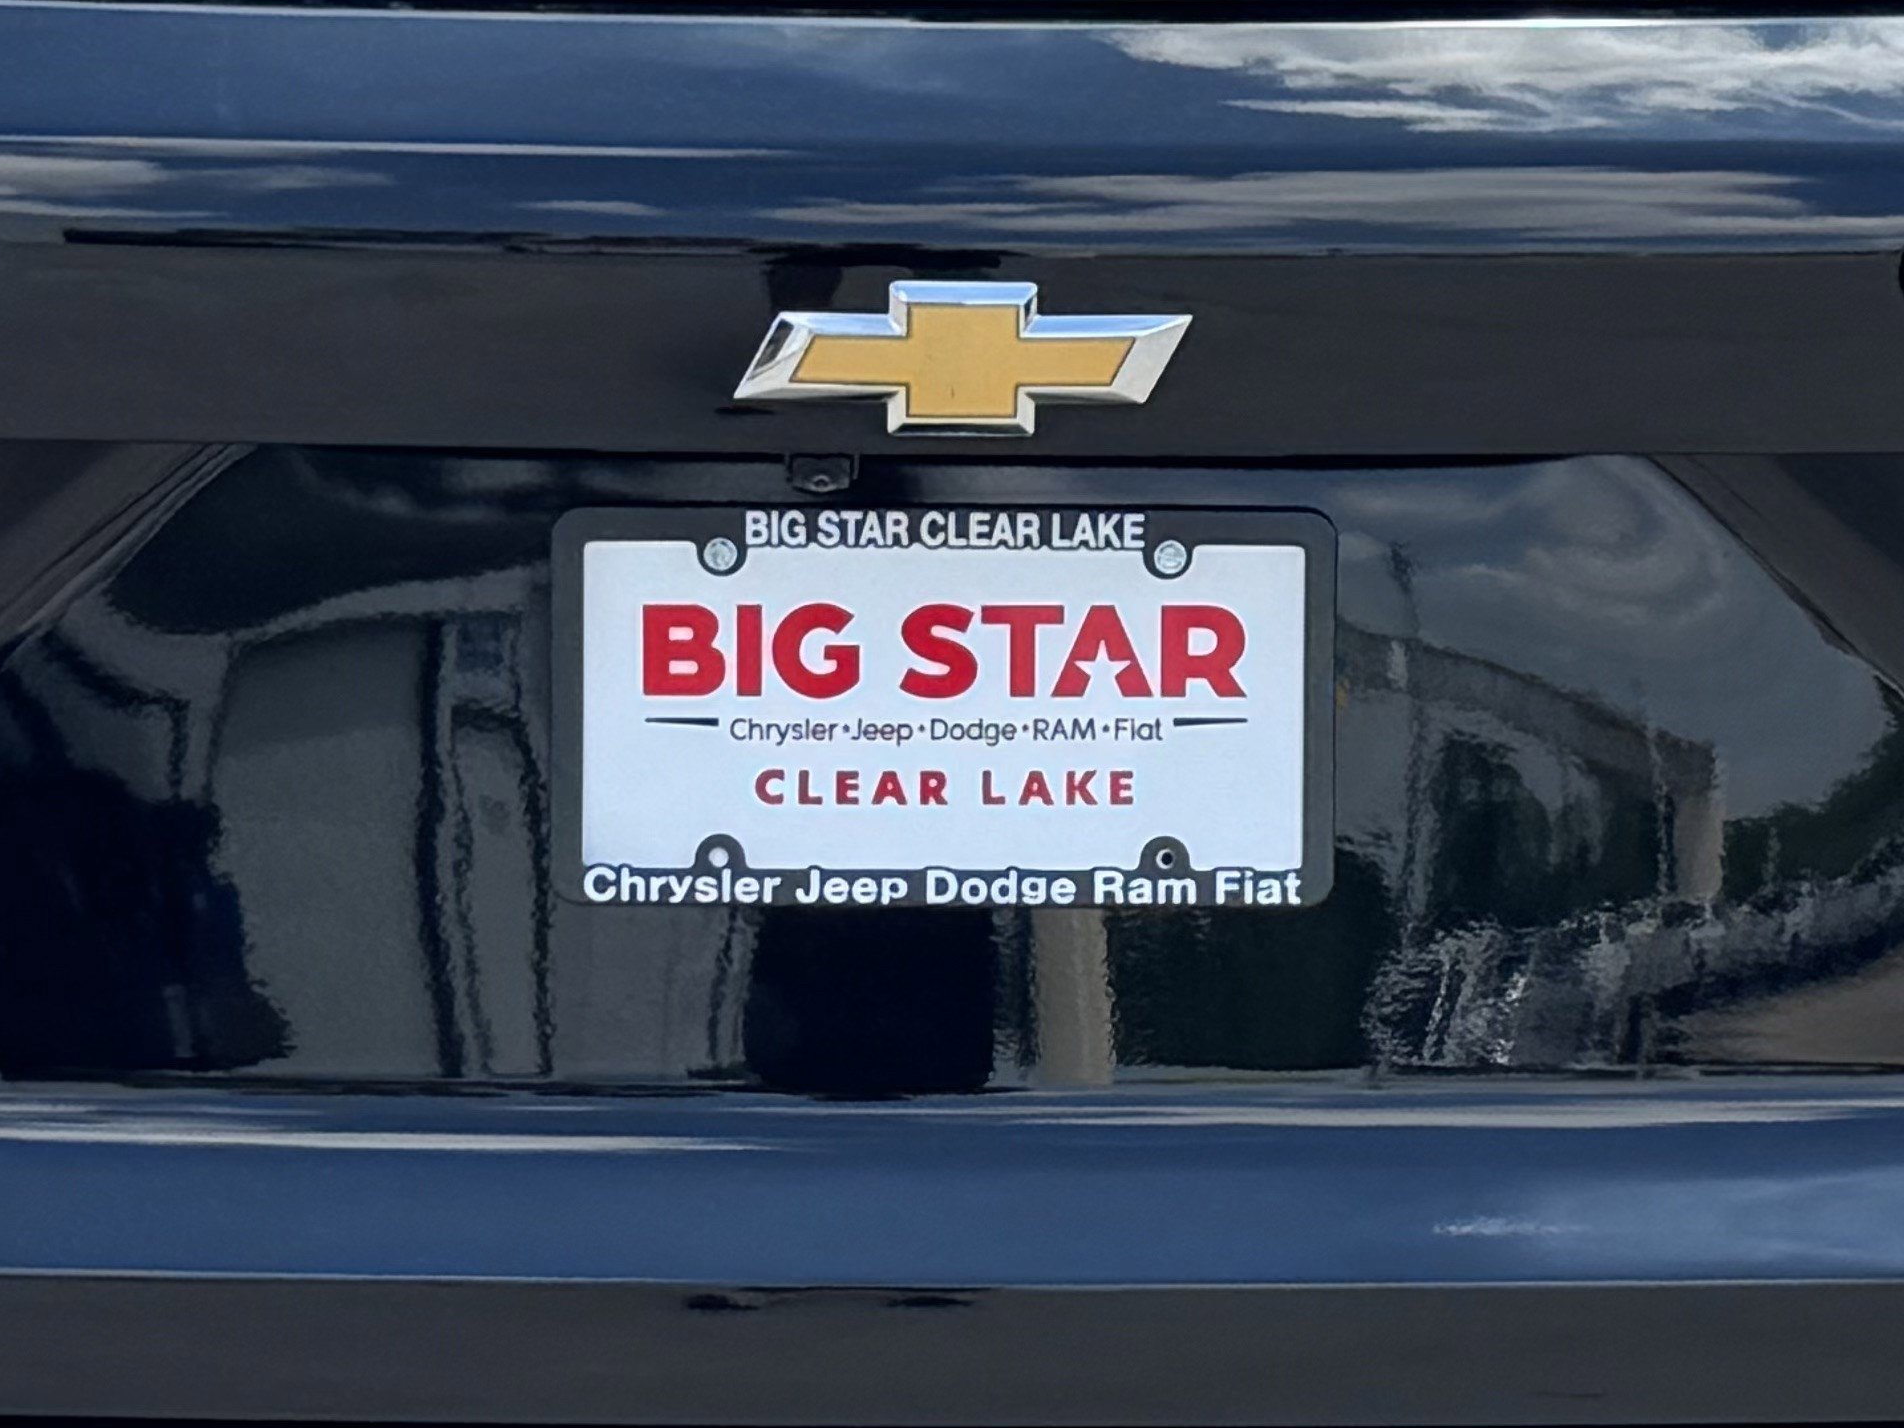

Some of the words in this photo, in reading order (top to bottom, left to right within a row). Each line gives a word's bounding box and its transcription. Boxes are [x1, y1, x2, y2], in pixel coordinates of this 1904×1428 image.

[745, 509, 807, 547] BIG
[816, 509, 910, 547] STAR
[919, 510, 1041, 549] CLEAR
[1051, 512, 1146, 550] LAKE
[641, 602, 861, 699] BIG
[899, 602, 1248, 699] STAR
[754, 768, 949, 806] CLEAR
[981, 768, 1135, 806] LAKE
[582, 866, 782, 904] Chrysler
[795, 868, 909, 905] Jeep
[925, 869, 1078, 905] Dodge
[1093, 870, 1197, 905] Ram
[1214, 871, 1302, 905] Fiat
